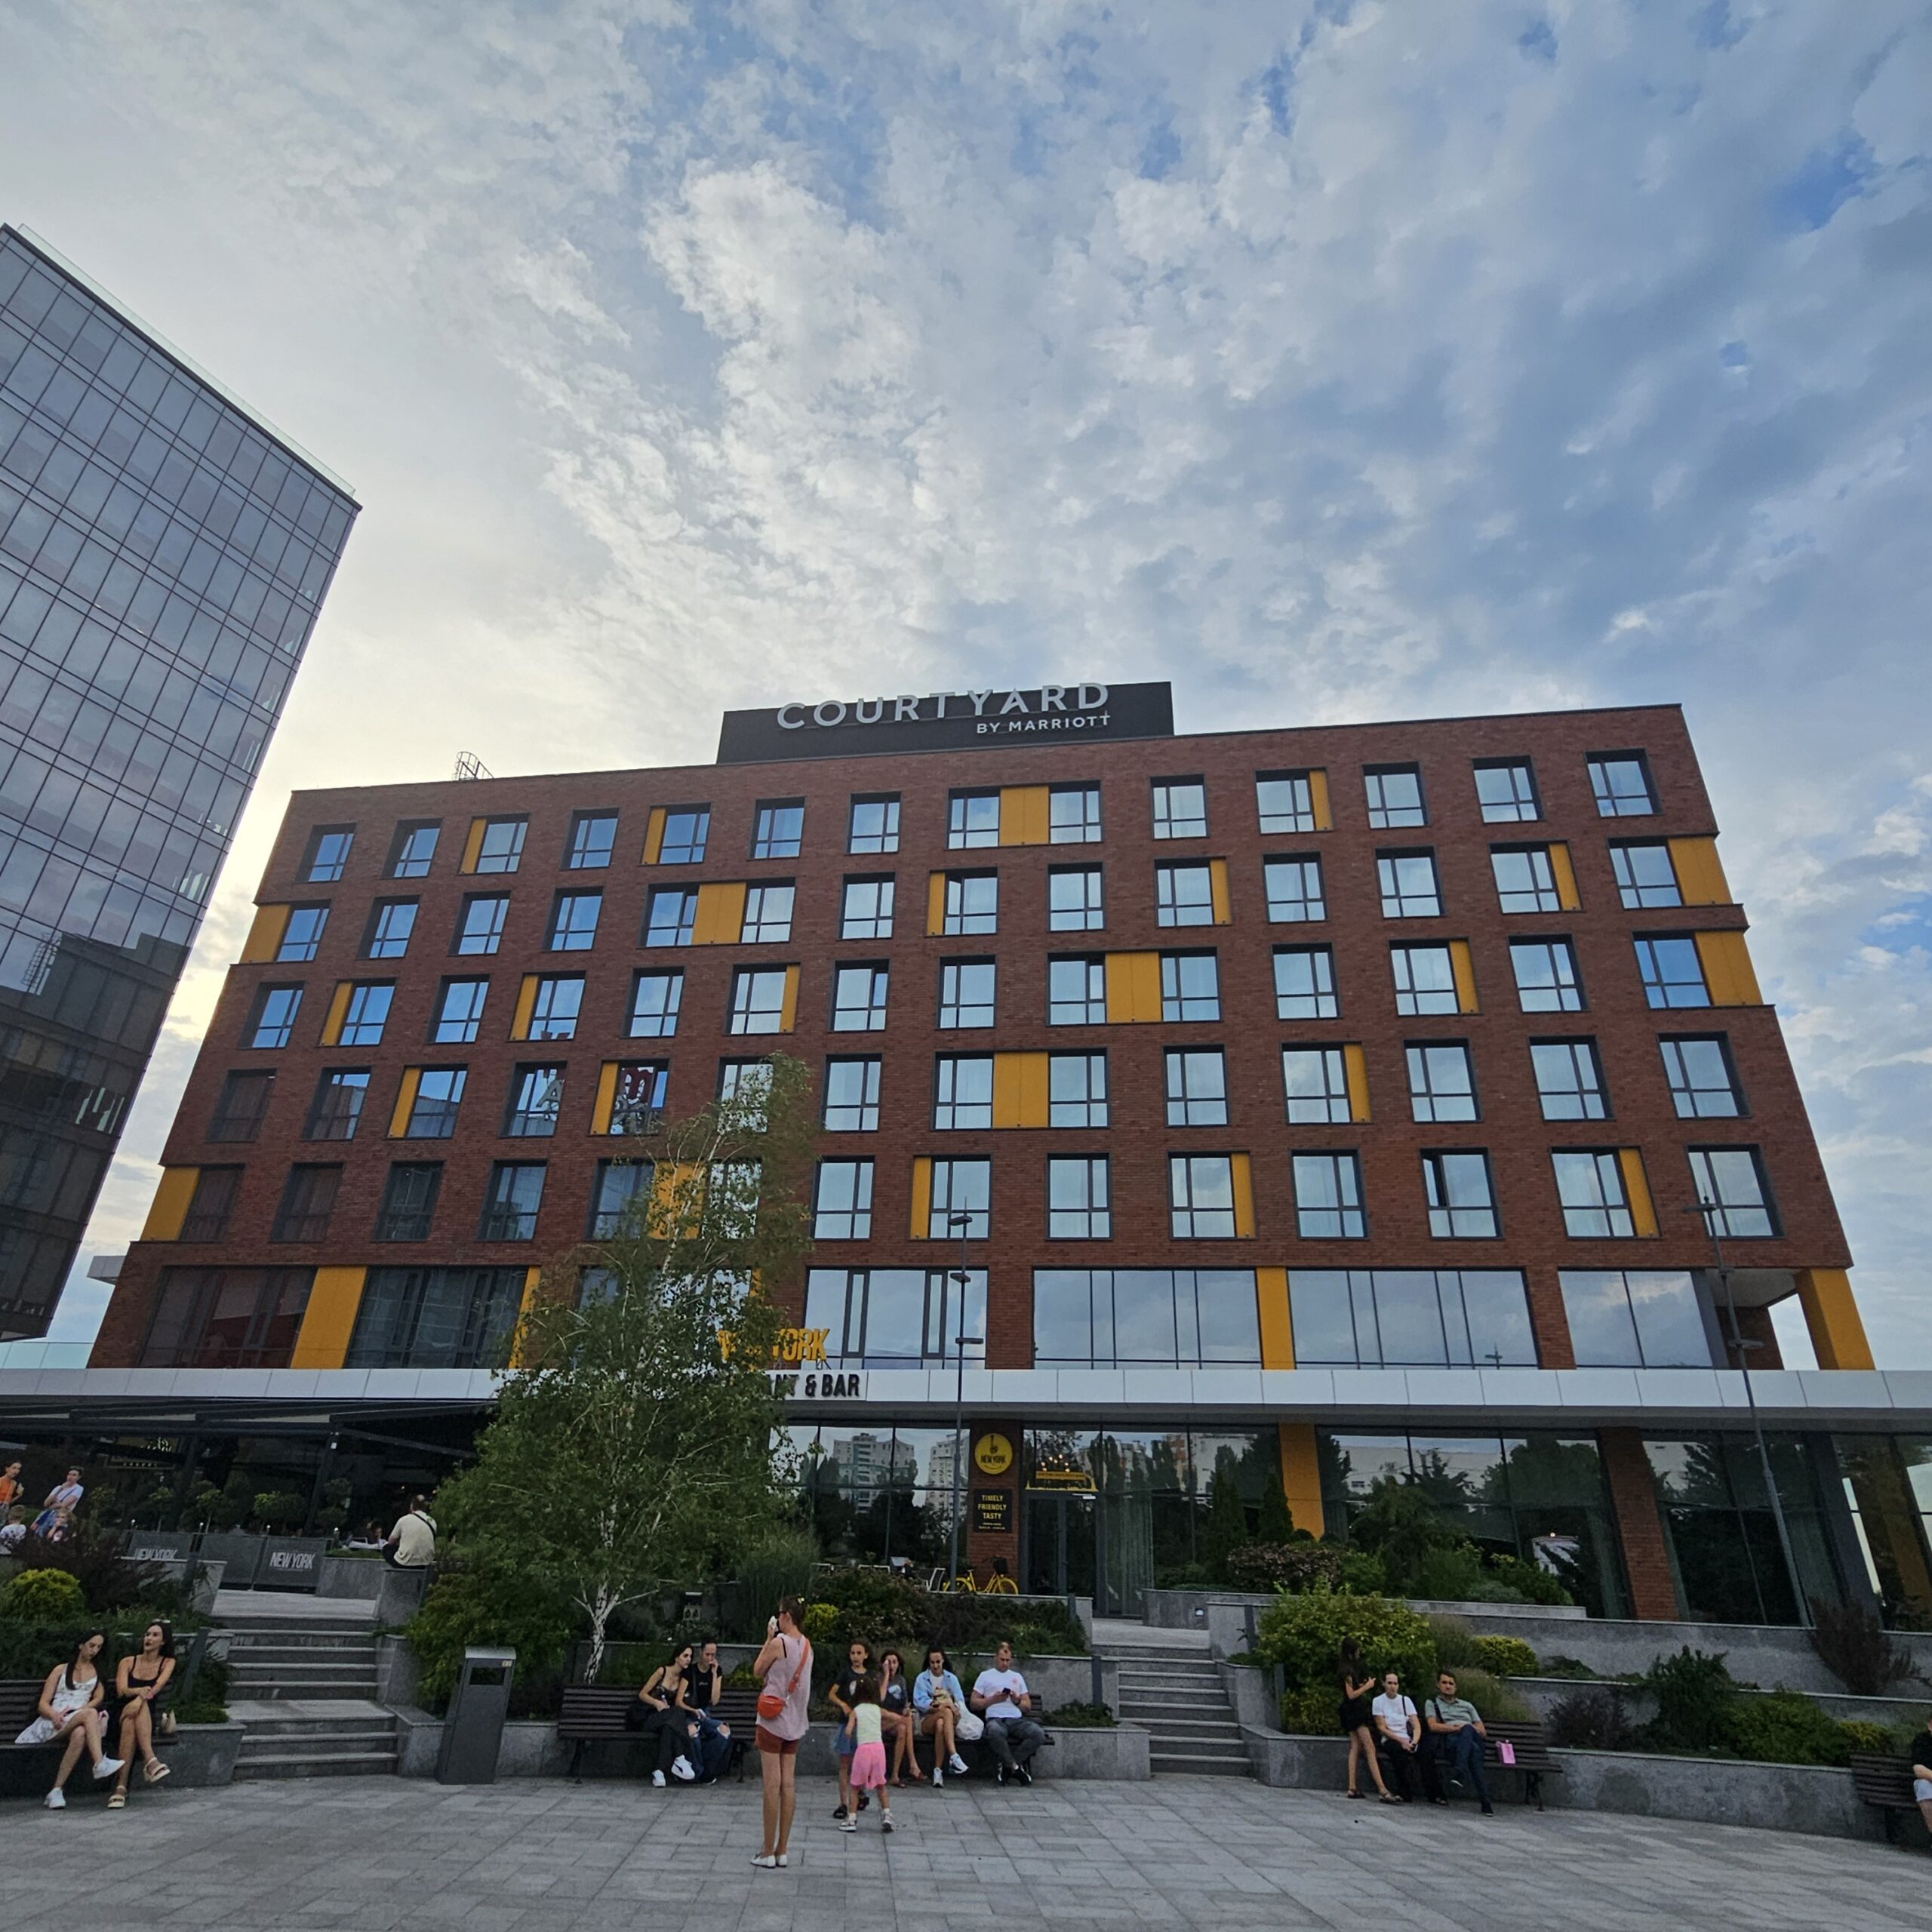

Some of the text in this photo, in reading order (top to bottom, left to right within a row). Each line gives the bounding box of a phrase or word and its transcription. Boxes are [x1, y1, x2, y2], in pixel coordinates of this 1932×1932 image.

[777, 682, 1109, 730] COURTYARD
[977, 709, 1110, 734] BY MARRIOTT
[804, 1374, 817, 1398] &
[821, 1374, 860, 1398] BAR
[981, 1455, 1006, 1464] NEW YORK
[269, 1552, 315, 1570] NEW YORK
